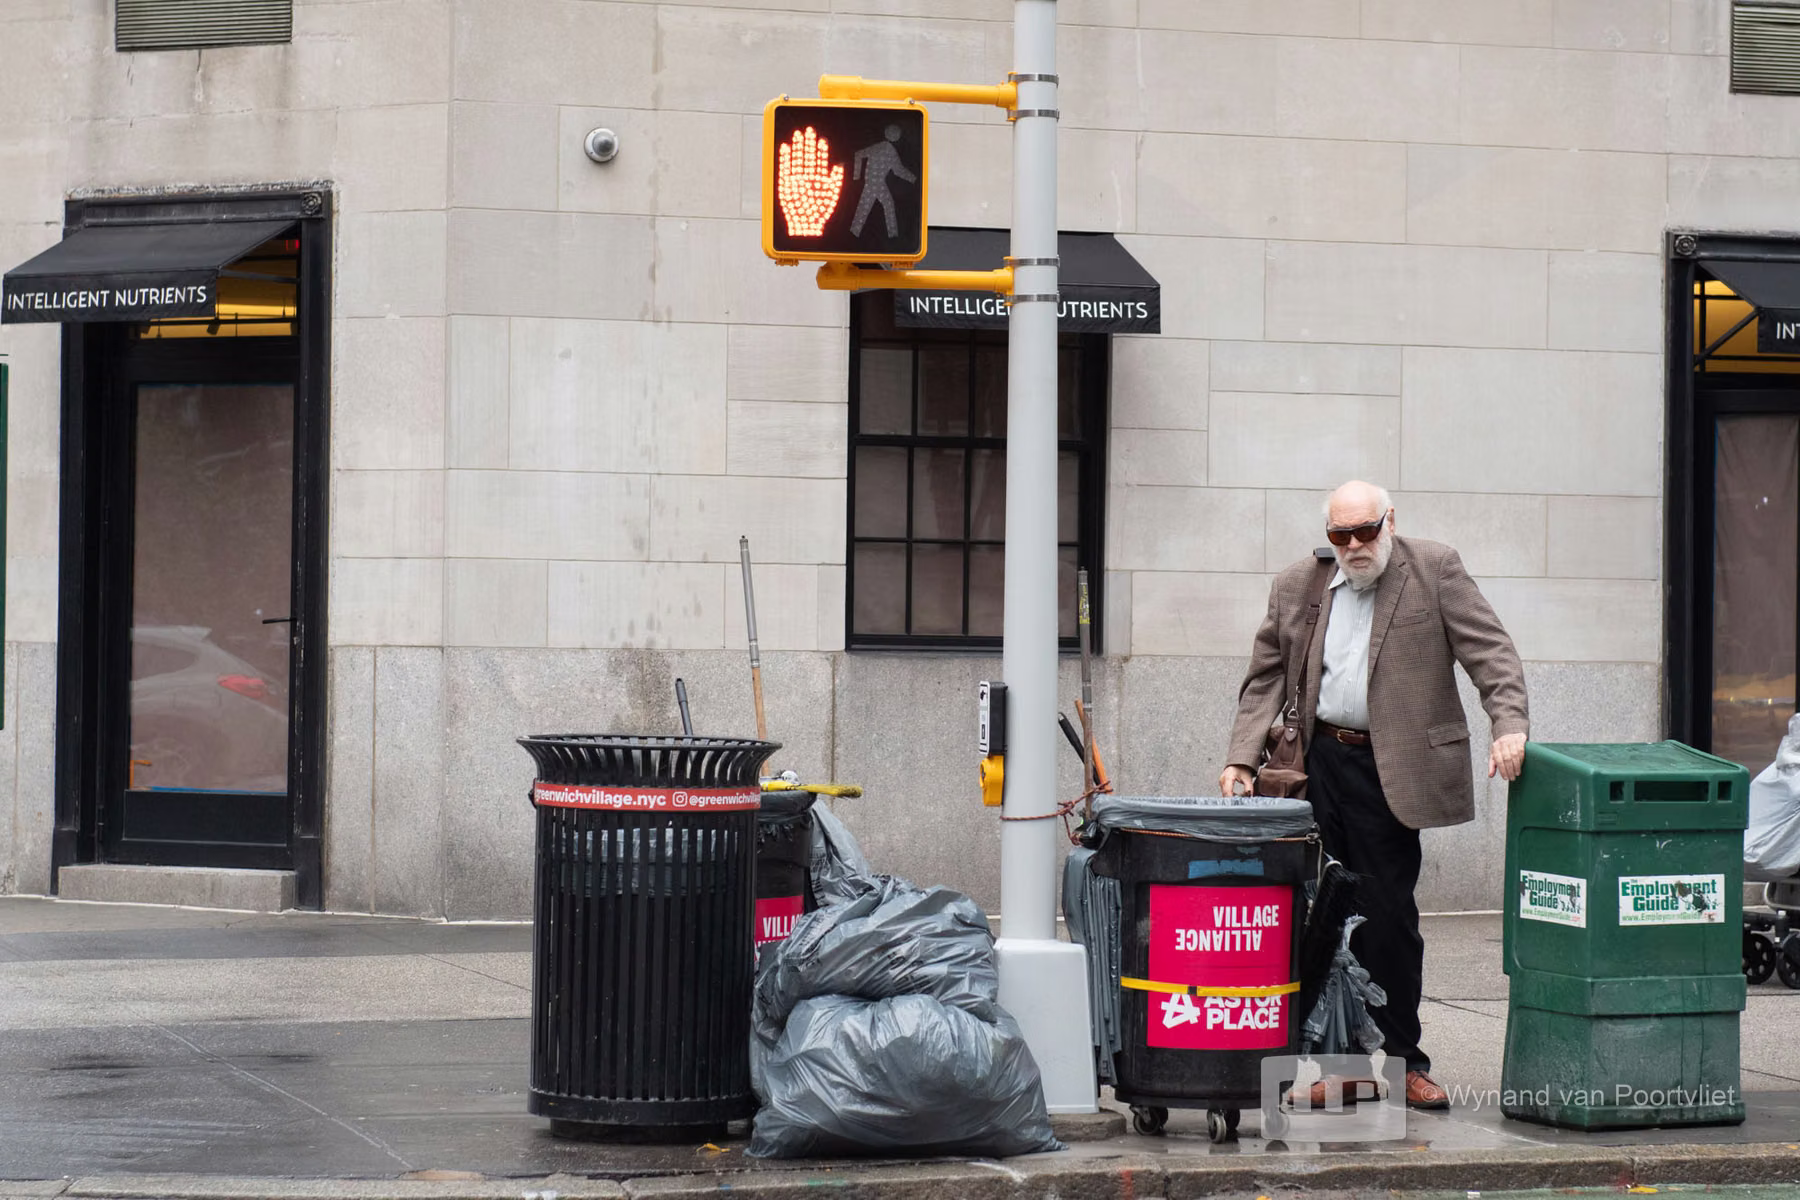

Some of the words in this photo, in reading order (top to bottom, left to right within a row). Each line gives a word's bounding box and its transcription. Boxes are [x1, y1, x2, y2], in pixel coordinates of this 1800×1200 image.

[7, 290, 110, 310] INTELLIGENT
[115, 286, 207, 307] NUTRIENTS
[910, 296, 1011, 316] INTELLIGE
[1056, 301, 1148, 318] UTRIENTS
[1529, 890, 1559, 909] Guide
[1633, 896, 1679, 911] Guide
[762, 913, 803, 938] VILLA
[1213, 905, 1280, 928] VILLAGE
[1175, 929, 1262, 952] ALLIANCE
[1206, 1006, 1280, 1030] PLACE
